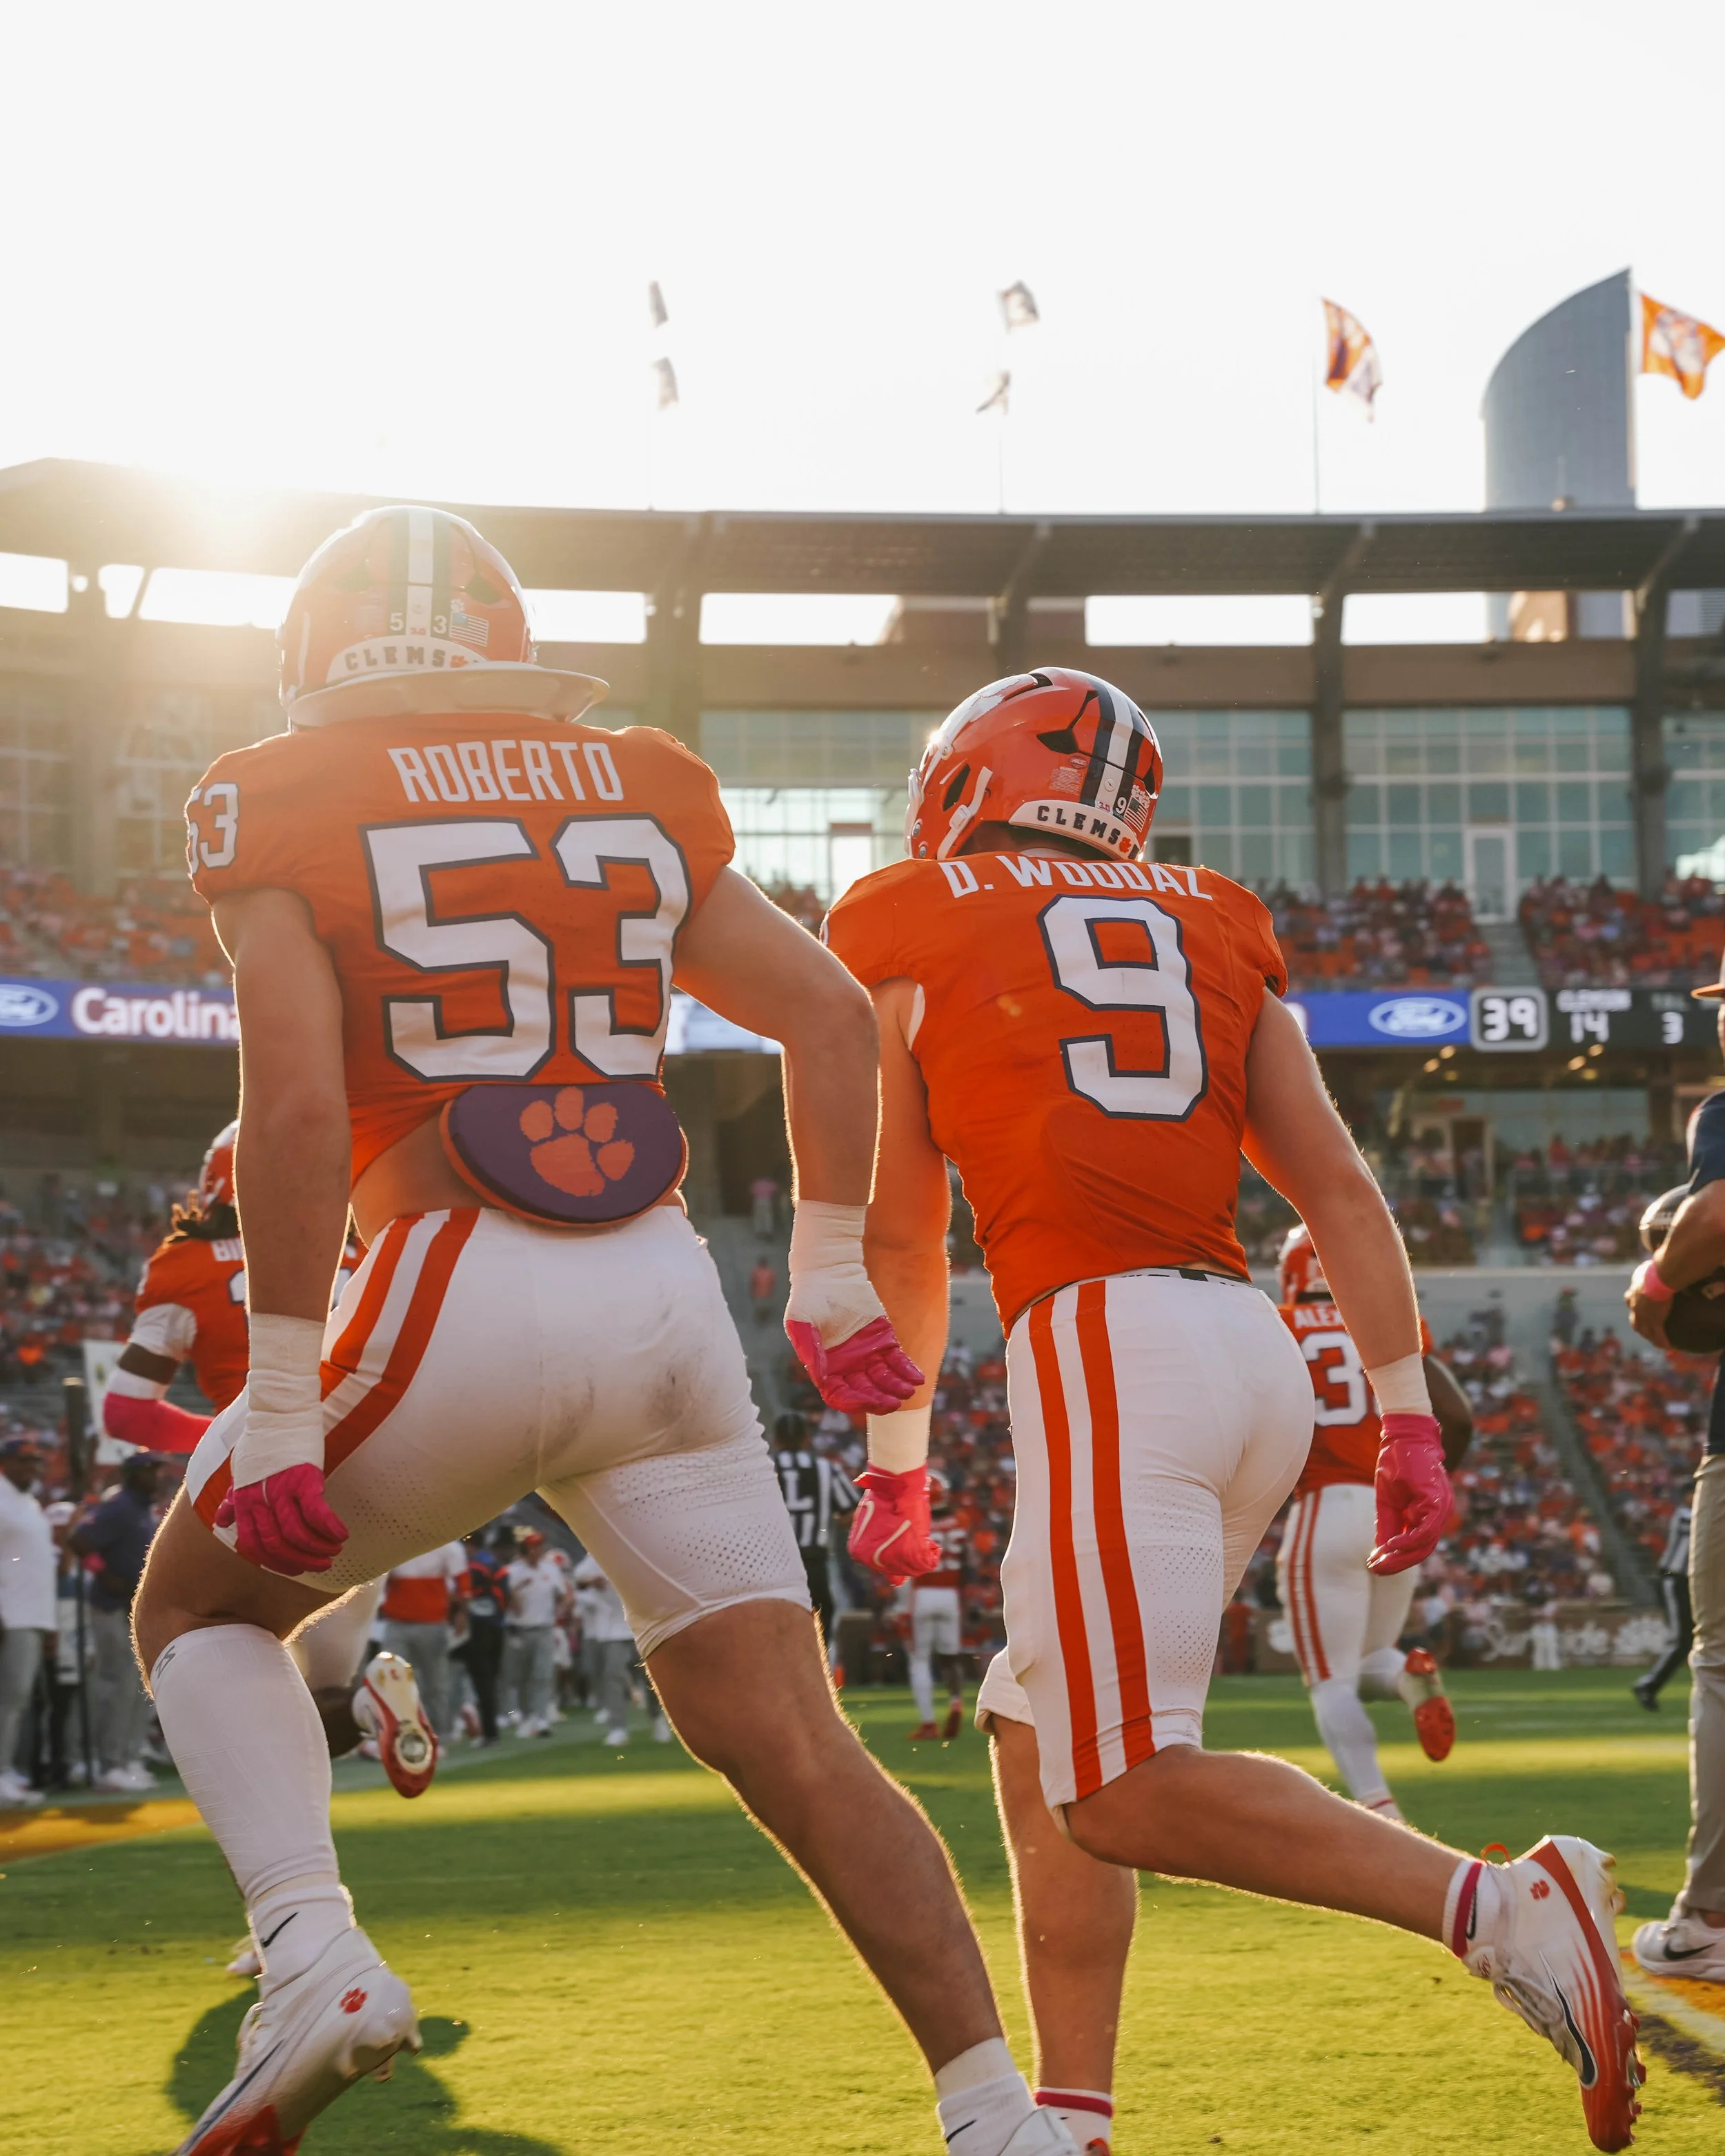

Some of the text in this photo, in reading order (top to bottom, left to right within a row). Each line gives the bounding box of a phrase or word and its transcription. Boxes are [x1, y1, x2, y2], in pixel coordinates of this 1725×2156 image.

[389, 611, 448, 634] 5 3
[387, 740, 624, 802] ROBERTO
[1115, 796, 1127, 815] 9
[938, 855, 1214, 901] D. WOODAZ
[358, 812, 693, 1083] 53
[1036, 893, 1209, 1122] 9
[1483, 998, 1537, 1041] 39
[1570, 1011, 1609, 1043] 14
[1662, 1011, 1684, 1044] 3
[1301, 1331, 1382, 1427] 3
[782, 1470, 814, 1511] L
